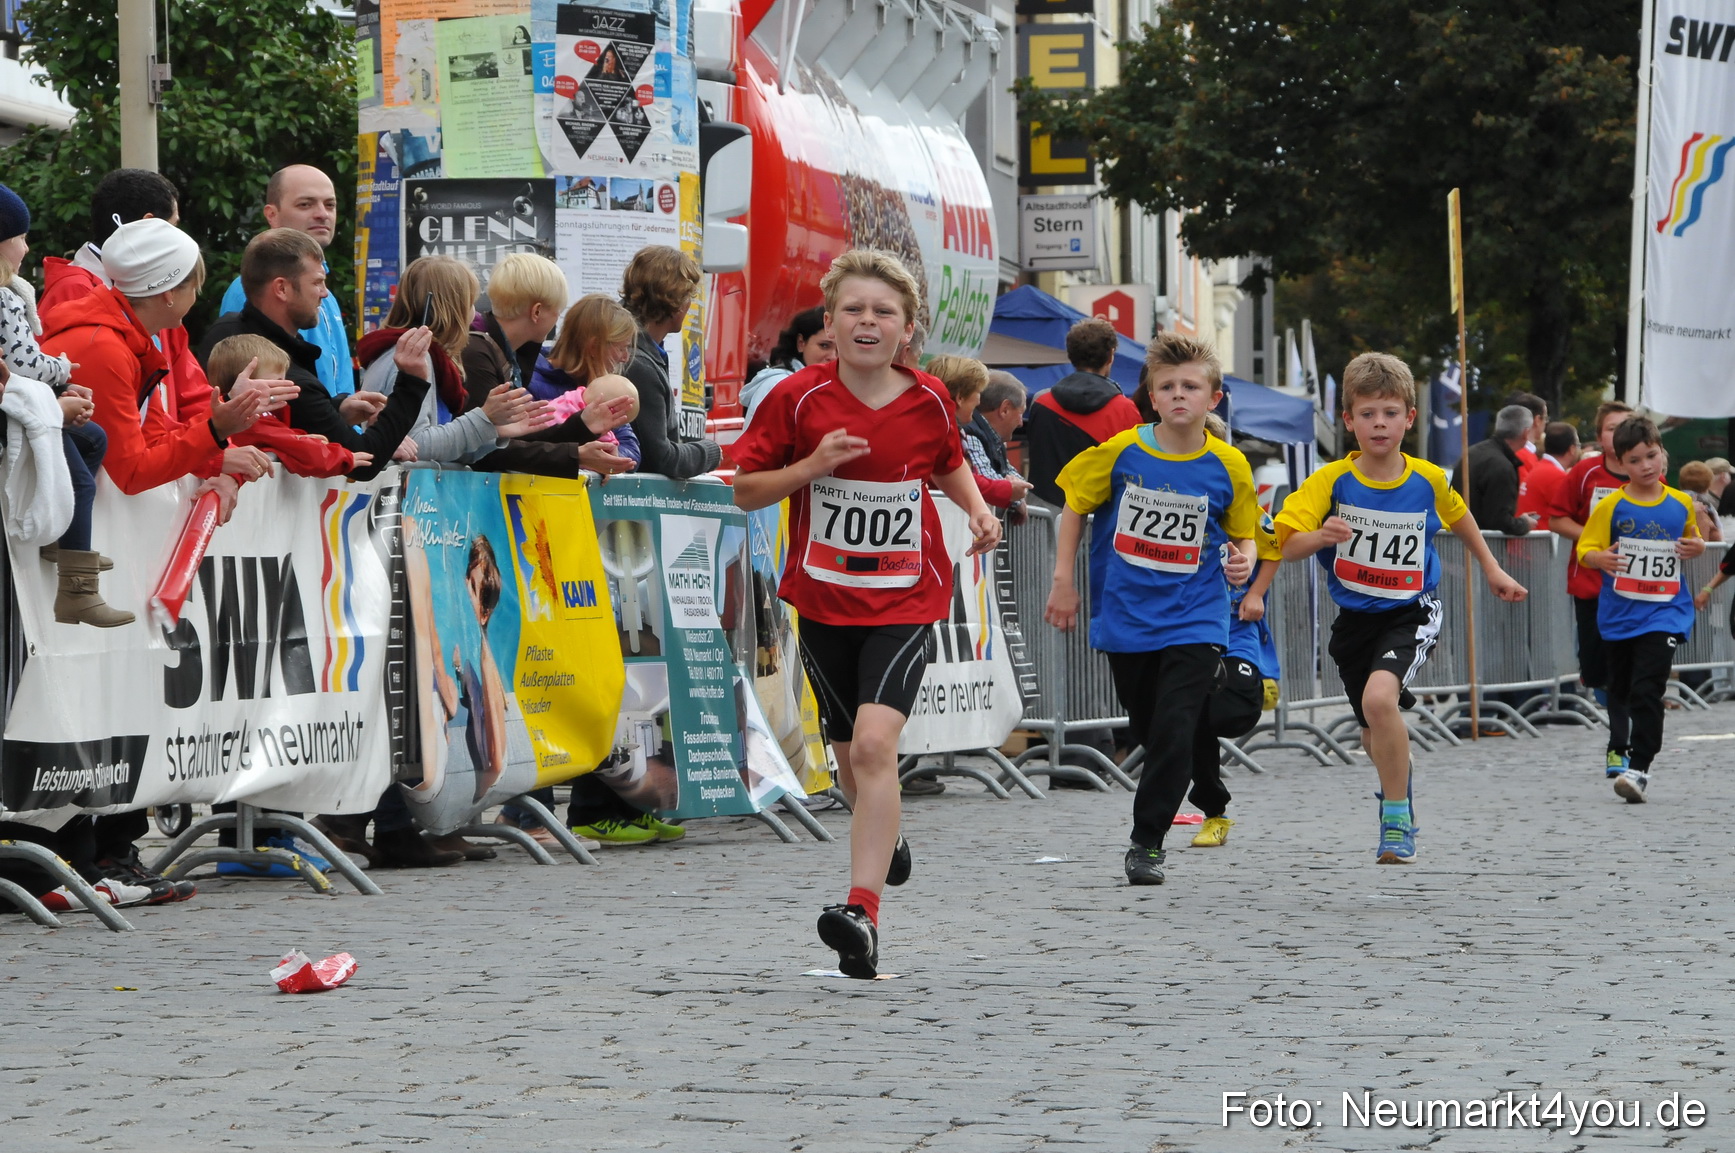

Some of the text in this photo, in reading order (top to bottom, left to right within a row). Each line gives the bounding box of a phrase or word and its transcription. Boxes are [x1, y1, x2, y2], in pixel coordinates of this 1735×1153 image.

[592, 15, 626, 32] JAZZ
[587, 154, 618, 162] NEUMARKT
[453, 202, 482, 210] FAMOUS
[936, 162, 993, 260] AVIA
[419, 216, 538, 243] GLENN
[1034, 217, 1083, 233] Stern
[1677, 326, 1732, 340] neumarkt
[603, 494, 613, 506] Seit
[813, 484, 906, 503] PARTL Neumarkt
[1125, 490, 1194, 510] PARTL Neumarkt
[822, 501, 913, 547] 7002
[1129, 504, 1198, 542] 7225
[1340, 513, 1414, 530] PARTL Neumarkt
[1134, 542, 1179, 560] Michael
[1348, 528, 1418, 565] 7142
[1620, 543, 1673, 554] PARTL Neumarkt
[880, 556, 920, 571] Bastian
[1625, 553, 1677, 578] 7153
[668, 573, 690, 589] MATHI
[1357, 569, 1398, 586] Marius
[525, 646, 554, 662] Pflaster
[520, 671, 575, 692] Außenplatten
[257, 710, 364, 768] neumarkt
[687, 768, 712, 784] Komplette
[700, 785, 735, 802] Designdecken
